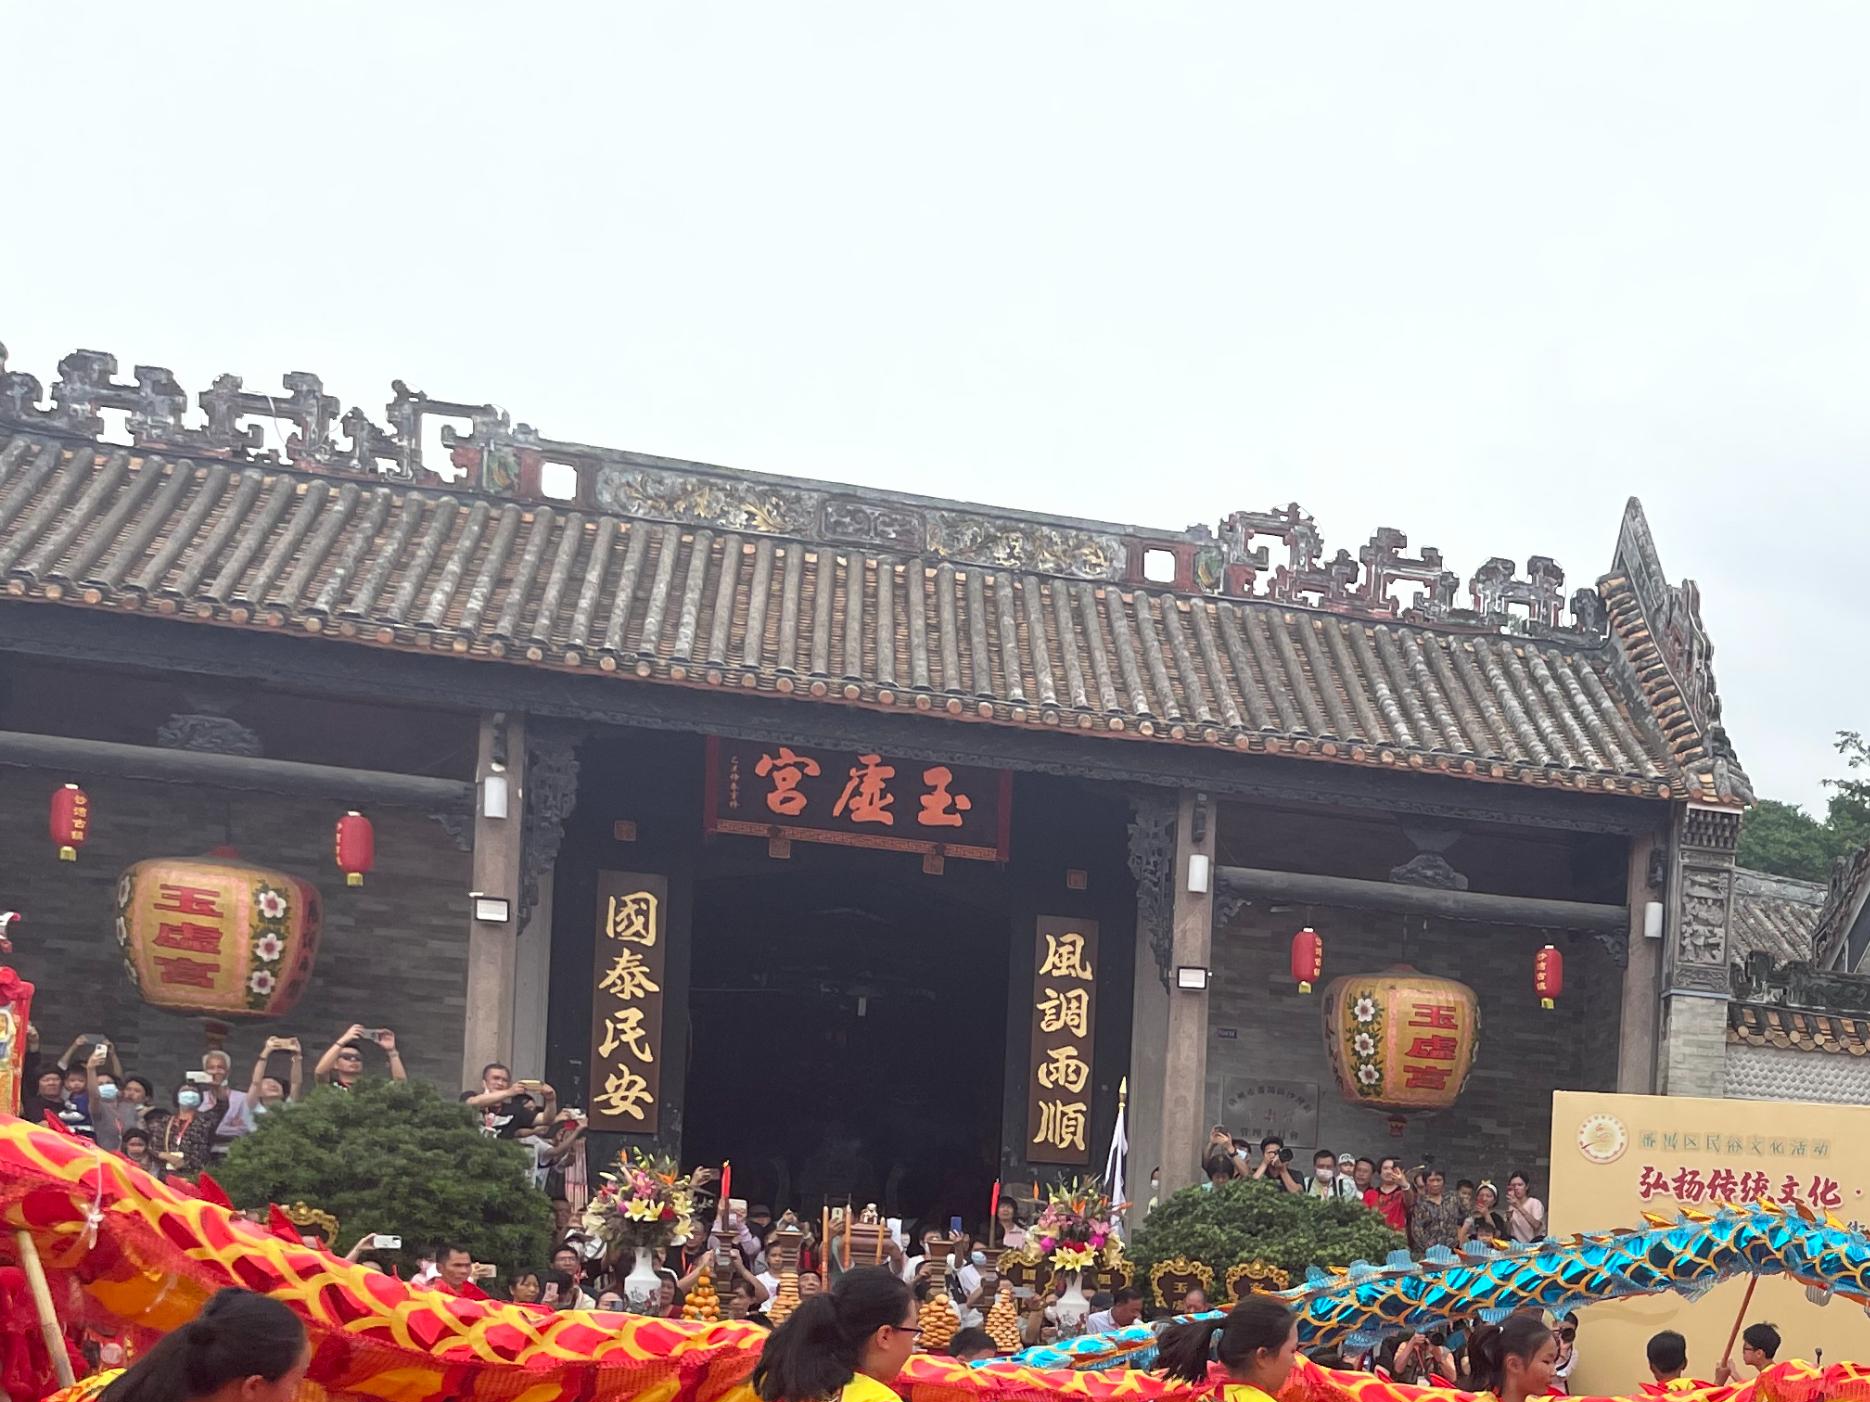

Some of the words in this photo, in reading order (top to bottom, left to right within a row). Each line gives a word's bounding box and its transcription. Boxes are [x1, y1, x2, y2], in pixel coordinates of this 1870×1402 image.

[594, 891, 661, 1121] 國泰民安
[1033, 932, 1094, 1151] 風調雨順
